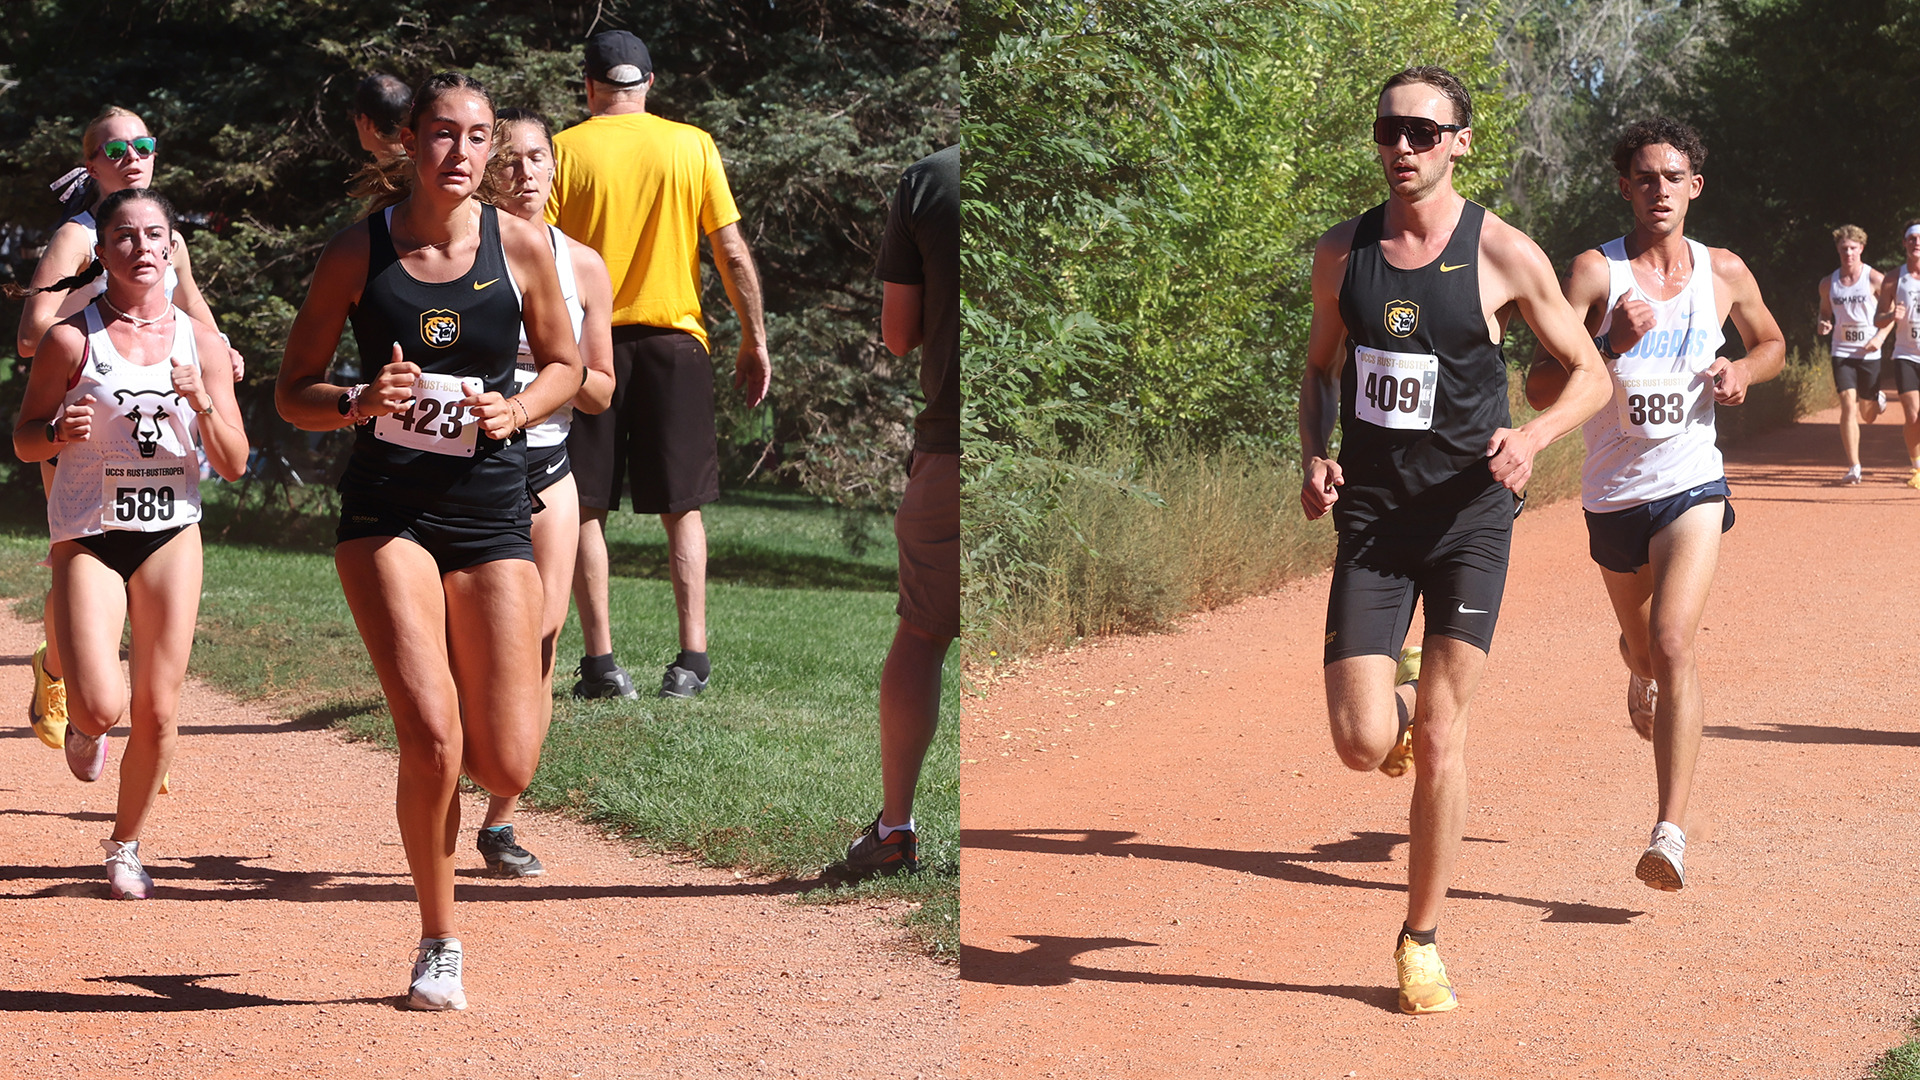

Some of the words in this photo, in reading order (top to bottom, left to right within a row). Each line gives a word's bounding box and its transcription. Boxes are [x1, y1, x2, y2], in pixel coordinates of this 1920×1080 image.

[1625, 328, 1707, 359] OUGARS
[1845, 330, 1865, 342] 690
[1361, 352, 1376, 364] UCCS
[1377, 356, 1429, 370] RUST-BUSTER
[1365, 372, 1420, 413] 409
[1622, 379, 1641, 388] UCCS
[392, 395, 464, 439] 423
[1628, 393, 1684, 426] 383
[105, 468, 125, 477] UCCS
[127, 467, 184, 477] RUST-BUSTEROPEN
[116, 486, 175, 521] 589
